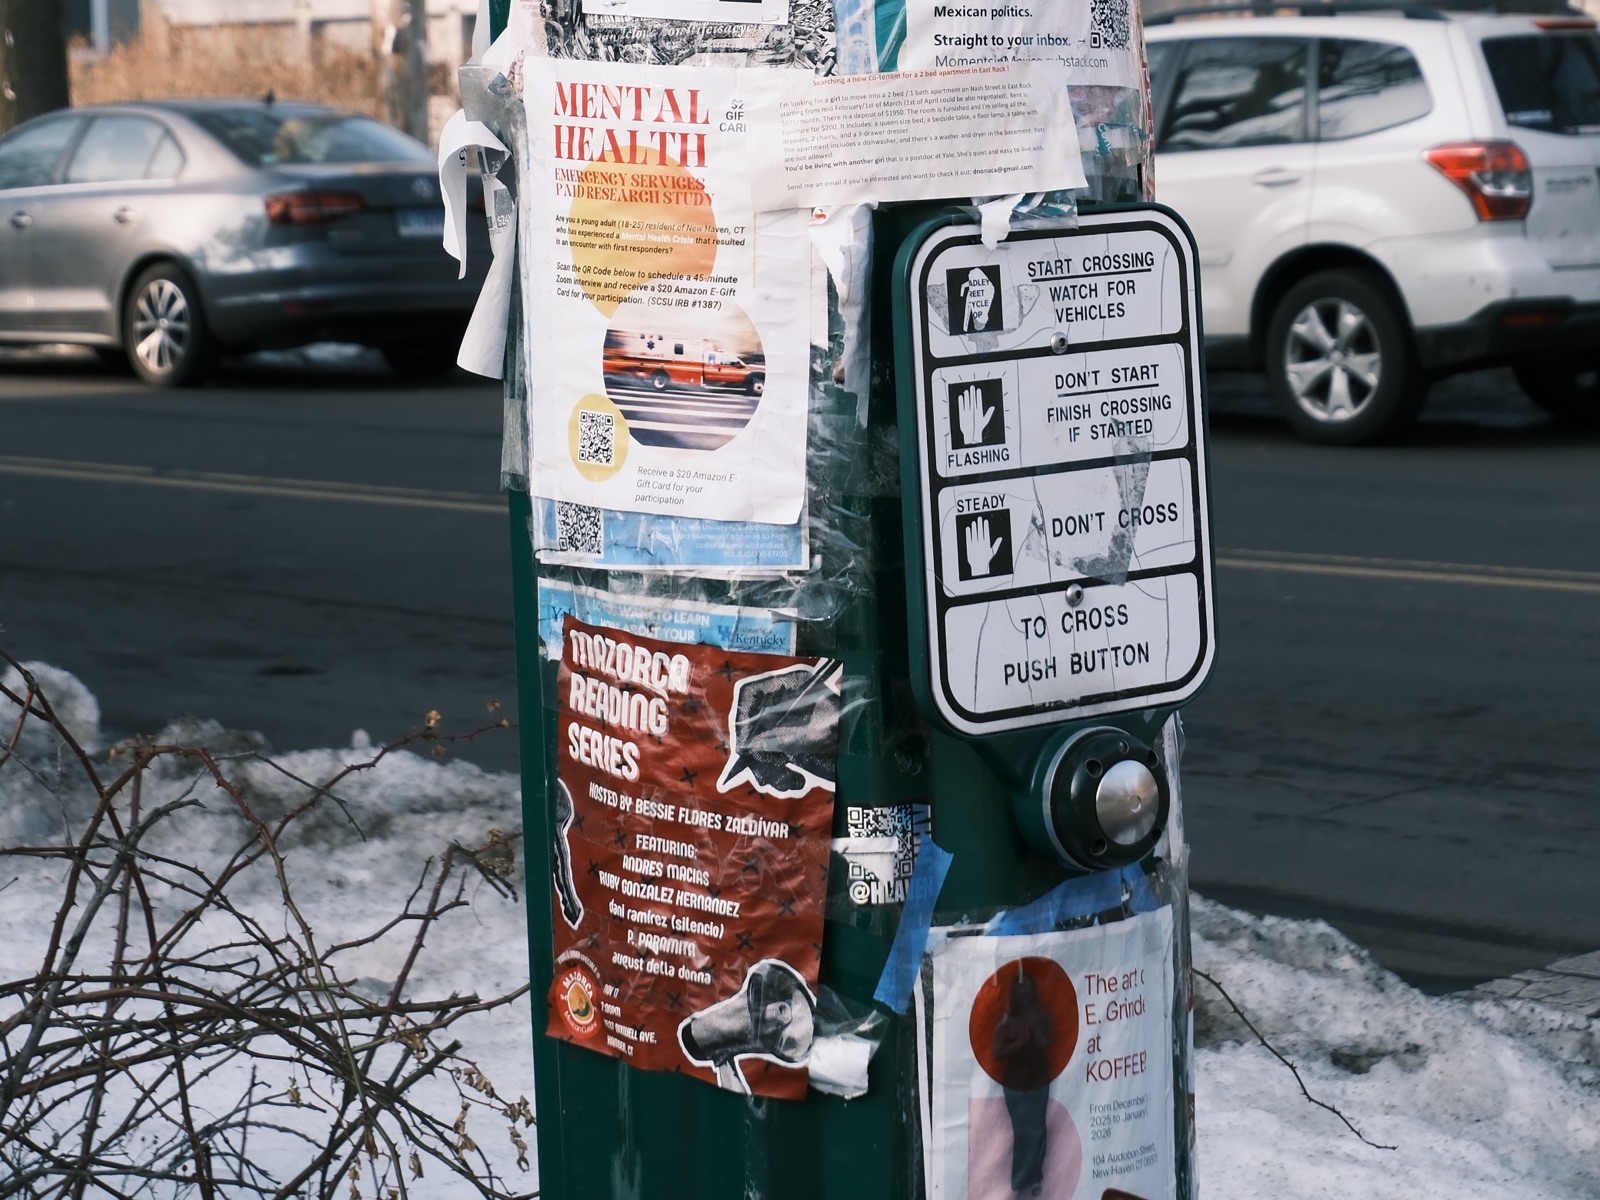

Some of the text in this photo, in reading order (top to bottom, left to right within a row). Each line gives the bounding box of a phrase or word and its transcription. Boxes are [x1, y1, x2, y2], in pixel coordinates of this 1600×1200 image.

[934, 6, 1032, 20] Mexican politics.
[934, 34, 1071, 49] Straight to your inbox.
[813, 78, 845, 86] Searching
[554, 81, 710, 125] MENTAL
[554, 125, 707, 168] HEALTH
[555, 168, 705, 191] EMERGENCY SERVICES
[556, 183, 715, 207] PAID RESEARCH STUDY
[557, 262, 570, 271] Scan
[572, 263, 581, 273] the
[582, 265, 591, 274] QR
[593, 267, 611, 275] Code
[614, 268, 636, 277] below
[638, 270, 645, 278] to
[648, 271, 684, 281] schedule
[693, 274, 738, 283] 45-minute
[1028, 252, 1154, 277] START CROSSING
[1049, 280, 1136, 301] WATCH FOR
[969, 300, 988, 308] YCLE
[1056, 302, 1125, 322] VEHICLES
[1055, 364, 1159, 389] DON'T START
[1047, 396, 1171, 422] FINISH CROSSING
[1069, 419, 1152, 442] IF STARTED
[948, 448, 1010, 468] FLASHING
[957, 494, 1006, 513] STEADY
[1052, 503, 1178, 537] DON'T CROSS
[1021, 604, 1128, 639] TO CROSS
[735, 633, 785, 646] Kentucky
[1004, 642, 1149, 685] PUSH BUTTON
[569, 673, 669, 735] READING
[568, 722, 640, 782] SERIES
[589, 781, 618, 808] HOSTED
[620, 797, 634, 812] BY
[679, 807, 722, 830] FLORES
[636, 834, 698, 859] FEATURING:
[622, 855, 709, 886] ANDRES MACIAS
[599, 870, 740, 919] RUBY GONZALEZ HERNANDEZ
[609, 899, 625, 918] dani
[671, 914, 724, 940] (silencio)
[627, 929, 696, 957] P. PARAMITA
[612, 951, 643, 973] august
[646, 960, 675, 978] della
[678, 966, 711, 985] donna
[1085, 974, 1118, 995] The
[1085, 1003, 1101, 1025] E.
[1087, 1033, 1101, 1054] at
[1090, 1103, 1111, 1114] From
[1091, 1114, 1111, 1126] 2025
[1113, 1115, 1120, 1123] to
[1091, 1127, 1111, 1140] 2026
